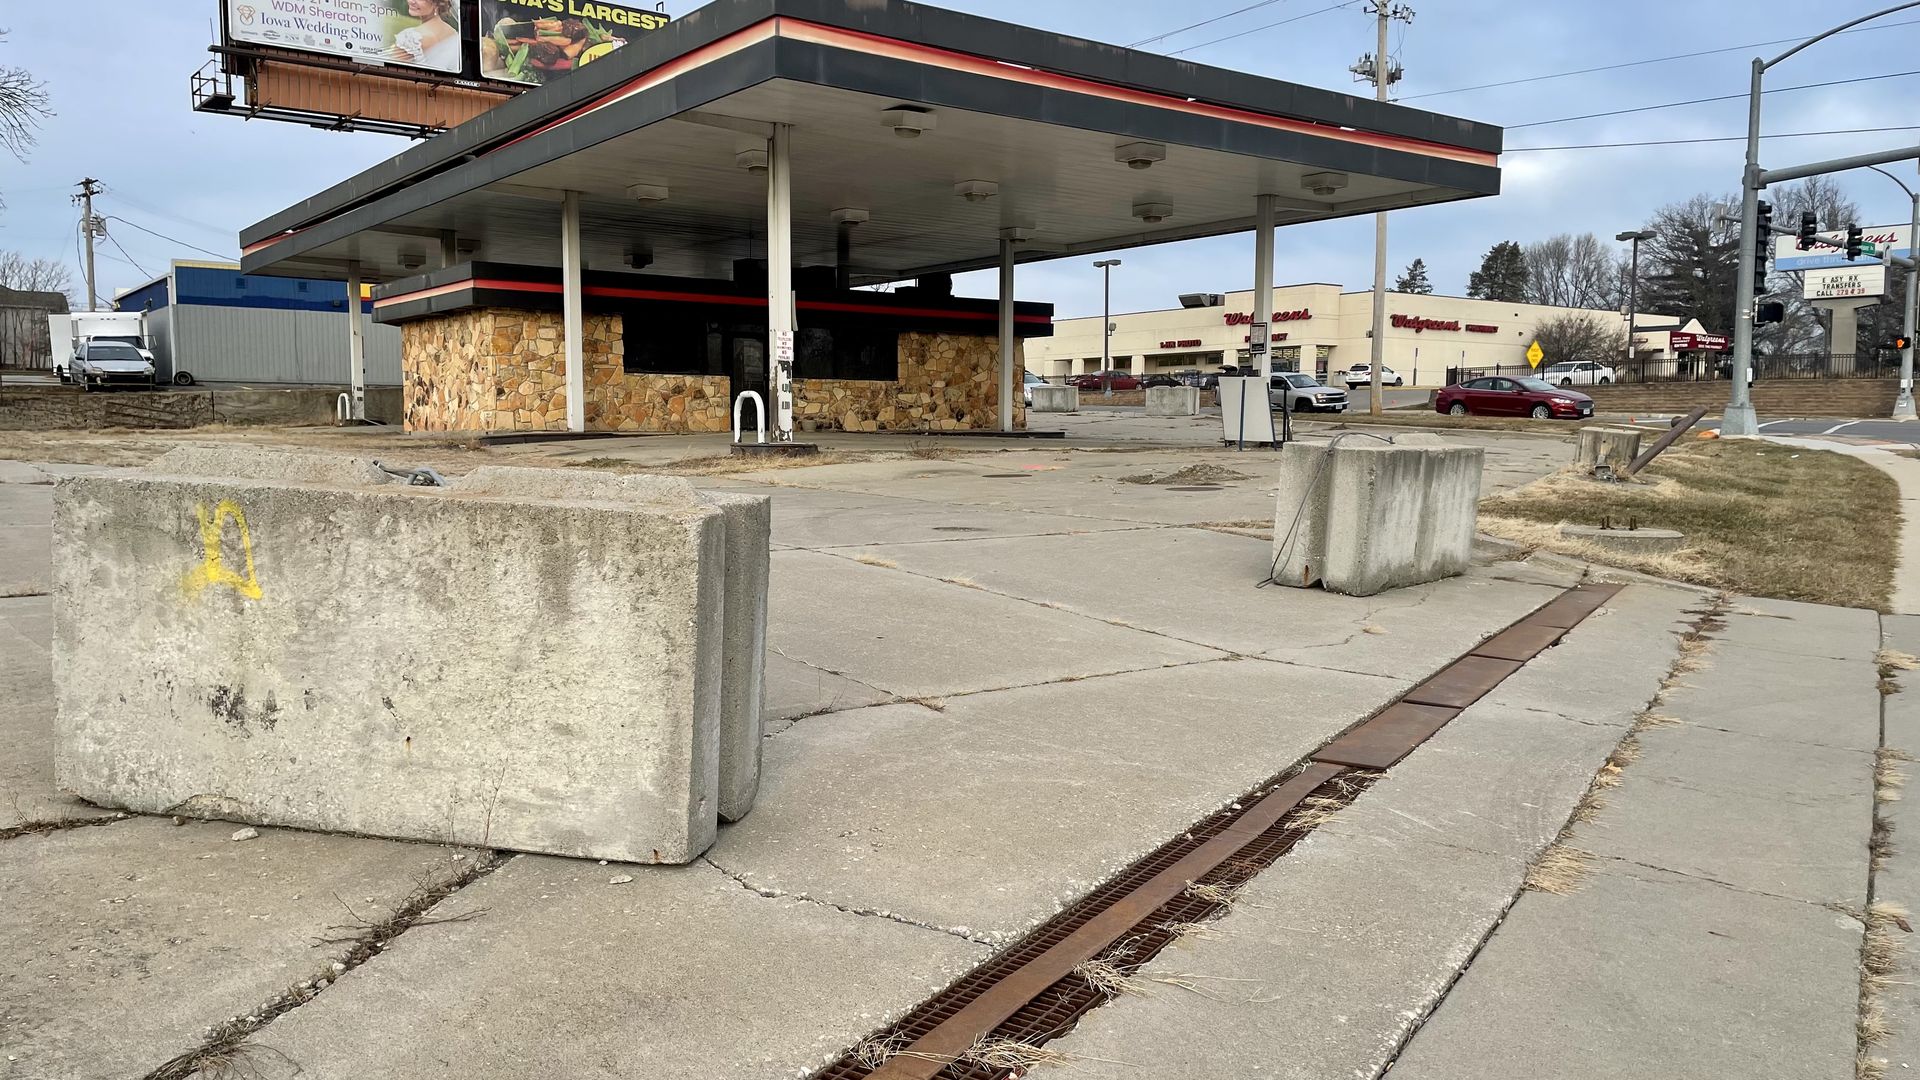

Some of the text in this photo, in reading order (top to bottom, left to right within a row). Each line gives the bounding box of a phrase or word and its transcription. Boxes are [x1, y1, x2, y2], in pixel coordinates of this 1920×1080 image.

[271, 0, 367, 24] WDM Sheraton
[568, 0, 668, 30] LARGEST
[261, 12, 291, 28] Iowa
[293, 17, 349, 40] Wedding
[351, 26, 383, 42] Show
[1390, 314, 1461, 333] Walgreens
